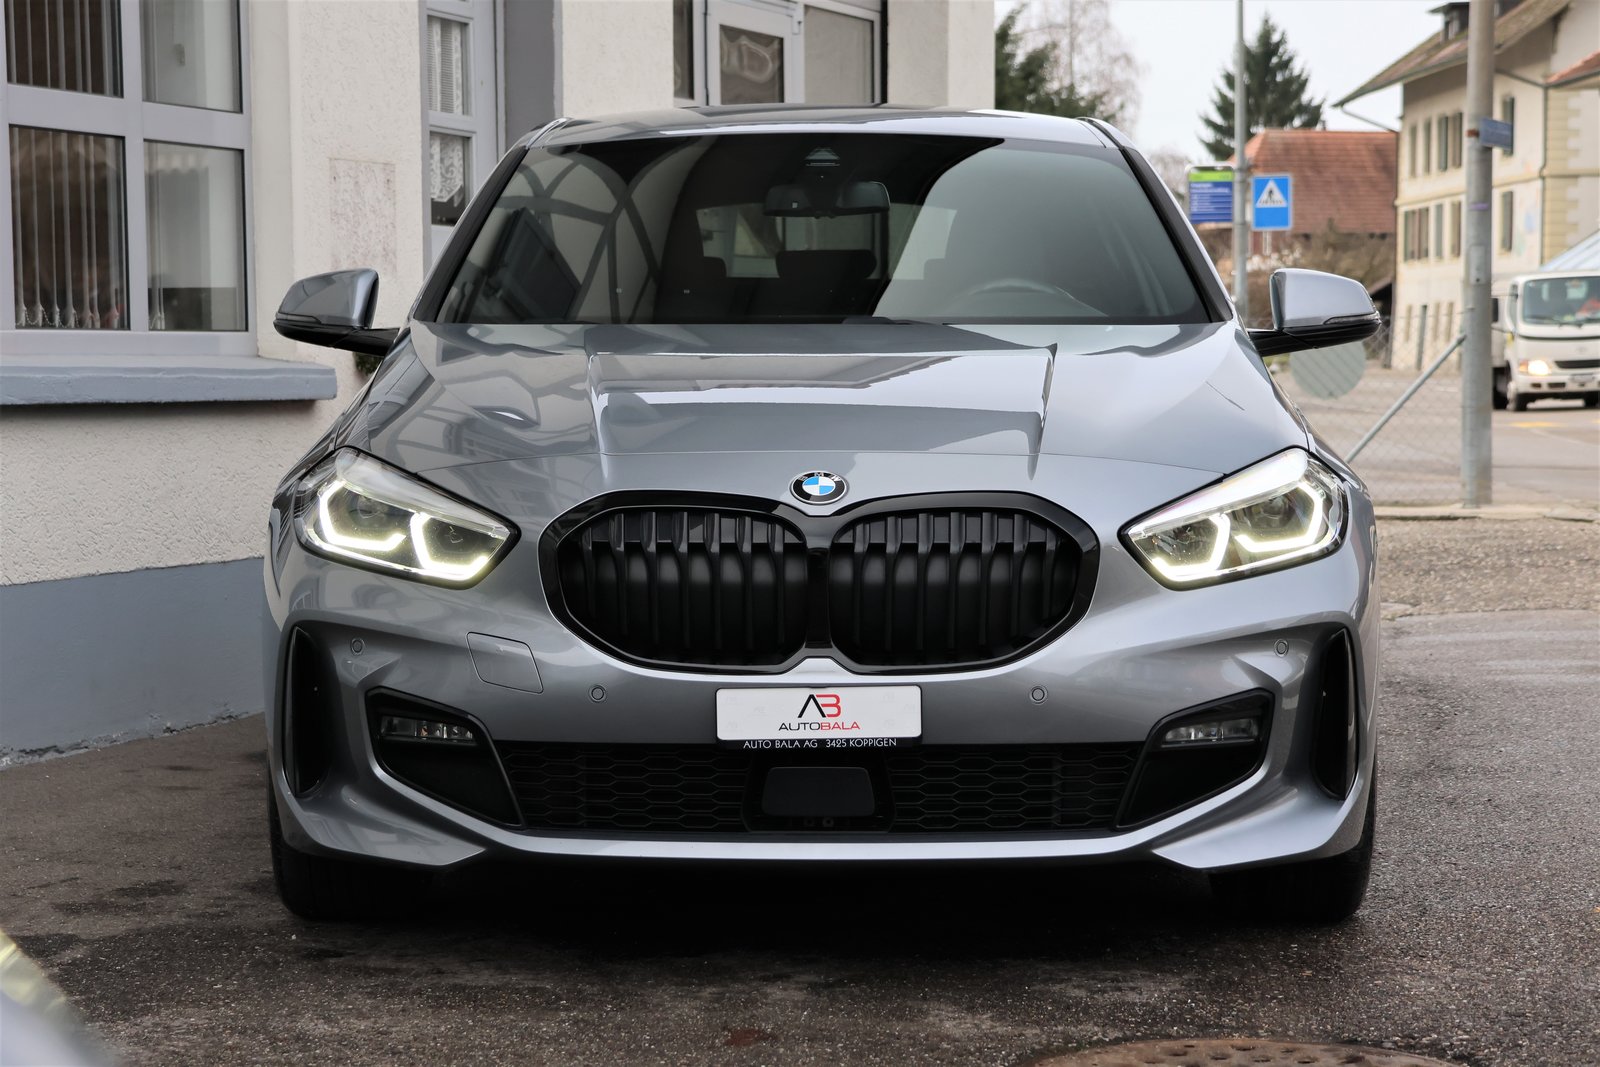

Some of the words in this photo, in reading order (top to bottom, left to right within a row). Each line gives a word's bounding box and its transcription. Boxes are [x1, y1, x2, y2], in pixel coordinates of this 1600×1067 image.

[797, 693, 842, 718] AB
[778, 721, 861, 731] AUTOBALA
[743, 740, 772, 749] AUTO
[775, 739, 800, 748] BALA
[803, 739, 818, 748] AG
[825, 739, 847, 747] 3425
[849, 738, 897, 747] KOPPIGEN
